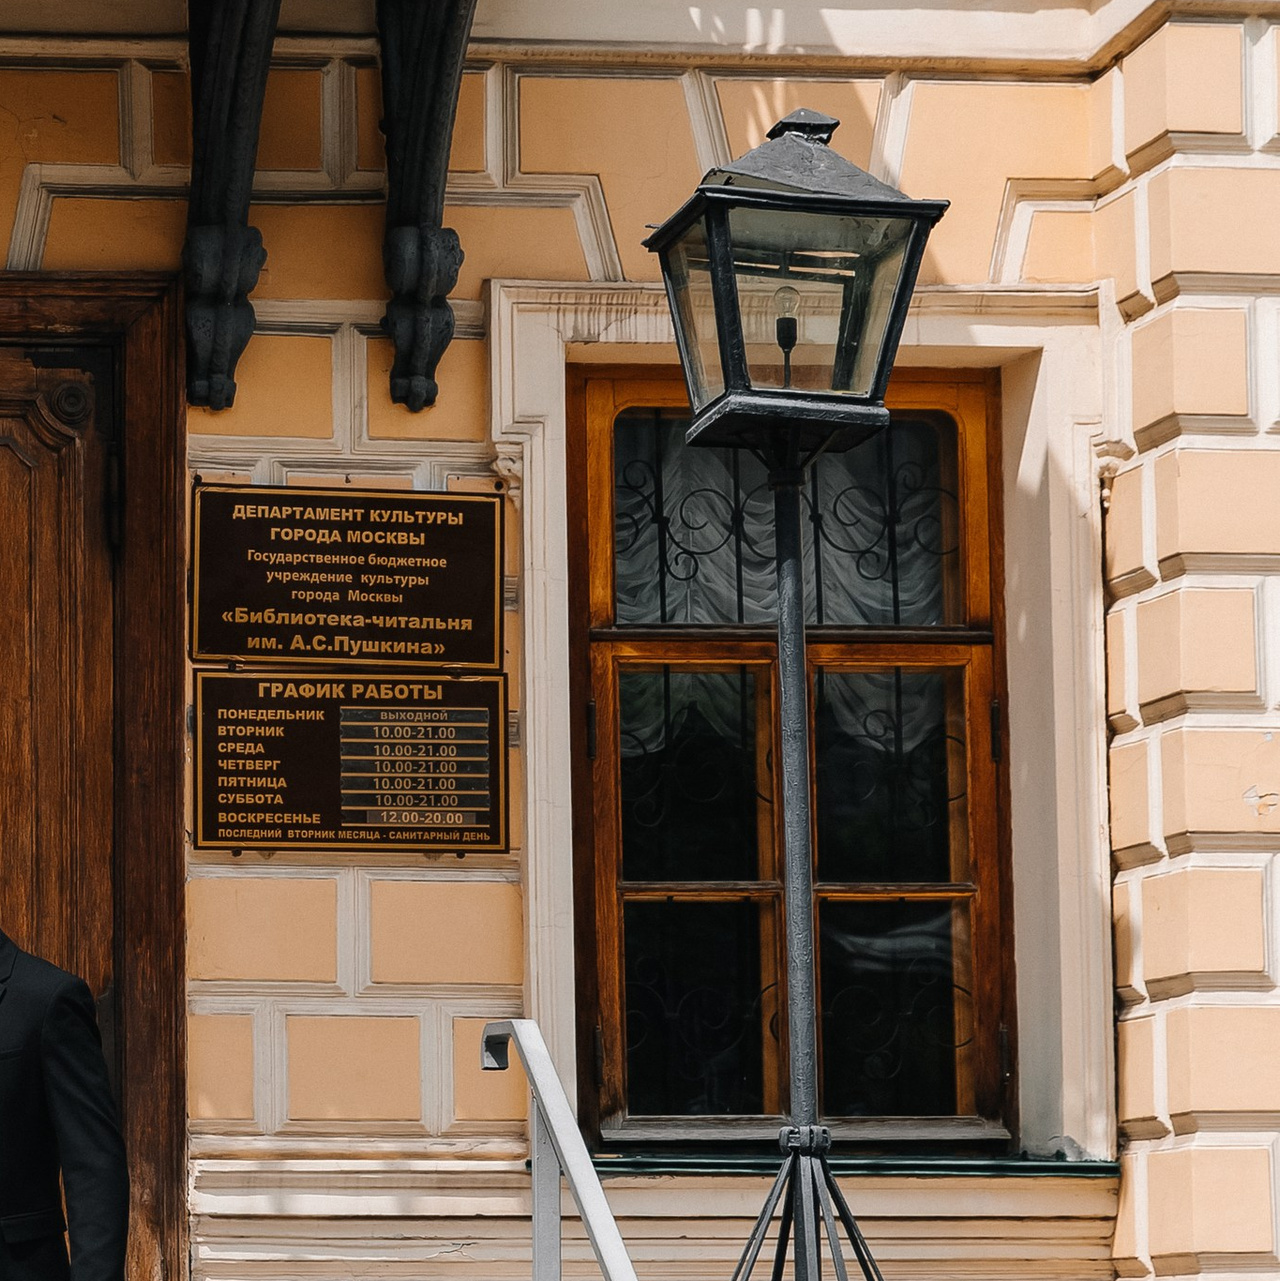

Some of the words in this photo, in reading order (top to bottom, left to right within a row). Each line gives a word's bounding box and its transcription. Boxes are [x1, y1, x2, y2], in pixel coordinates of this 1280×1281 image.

[233, 505, 364, 522] ДЕПАРТАМЕНТ
[369, 509, 463, 525] КУЛЬТУРЫ
[270, 527, 342, 544] ГОРОДА
[347, 530, 425, 545] МОСКВЫ
[247, 549, 365, 565] Государственное
[368, 553, 447, 568] бюджетное
[266, 570, 353, 583] учреждение
[361, 574, 429, 588] культуры
[291, 590, 340, 603] города
[348, 590, 403, 603] Москвы
[222, 607, 473, 630] «Библиотека-читальня
[247, 636, 283, 649] им.
[290, 635, 445, 655] А.С.Пушкина»
[258, 682, 345, 699] ГРАФИК
[352, 685, 442, 700] РАБОТЫ
[218, 709, 324, 721] ПОНЕДЕЛЬНИК
[218, 726, 284, 737] ВТОРНИК
[373, 726, 456, 739] 10.00-21.00
[218, 743, 264, 754] СРЕДА
[374, 745, 457, 757] 10.00-21.00
[218, 760, 281, 771] ЧЕТВЕРГ
[375, 761, 457, 773] 10.00-21.00
[218, 777, 287, 789] ПЯТНИЦА
[373, 778, 456, 790] 10.00-21.00
[218, 794, 283, 804] СУББОТА
[376, 795, 458, 807] 10.00-21.00
[218, 813, 321, 824] ВОСКРЕСЕНЬЕ
[381, 811, 463, 824] 12.00-20.00
[218, 828, 282, 838] ПОСЛЕДНИЙ
[288, 829, 335, 839] ВТОРНИК
[338, 830, 380, 840] МЕСЯЦА
[389, 830, 460, 840] САНИТАРНЫЙ
[462, 832, 491, 842] ДЕНЬ
